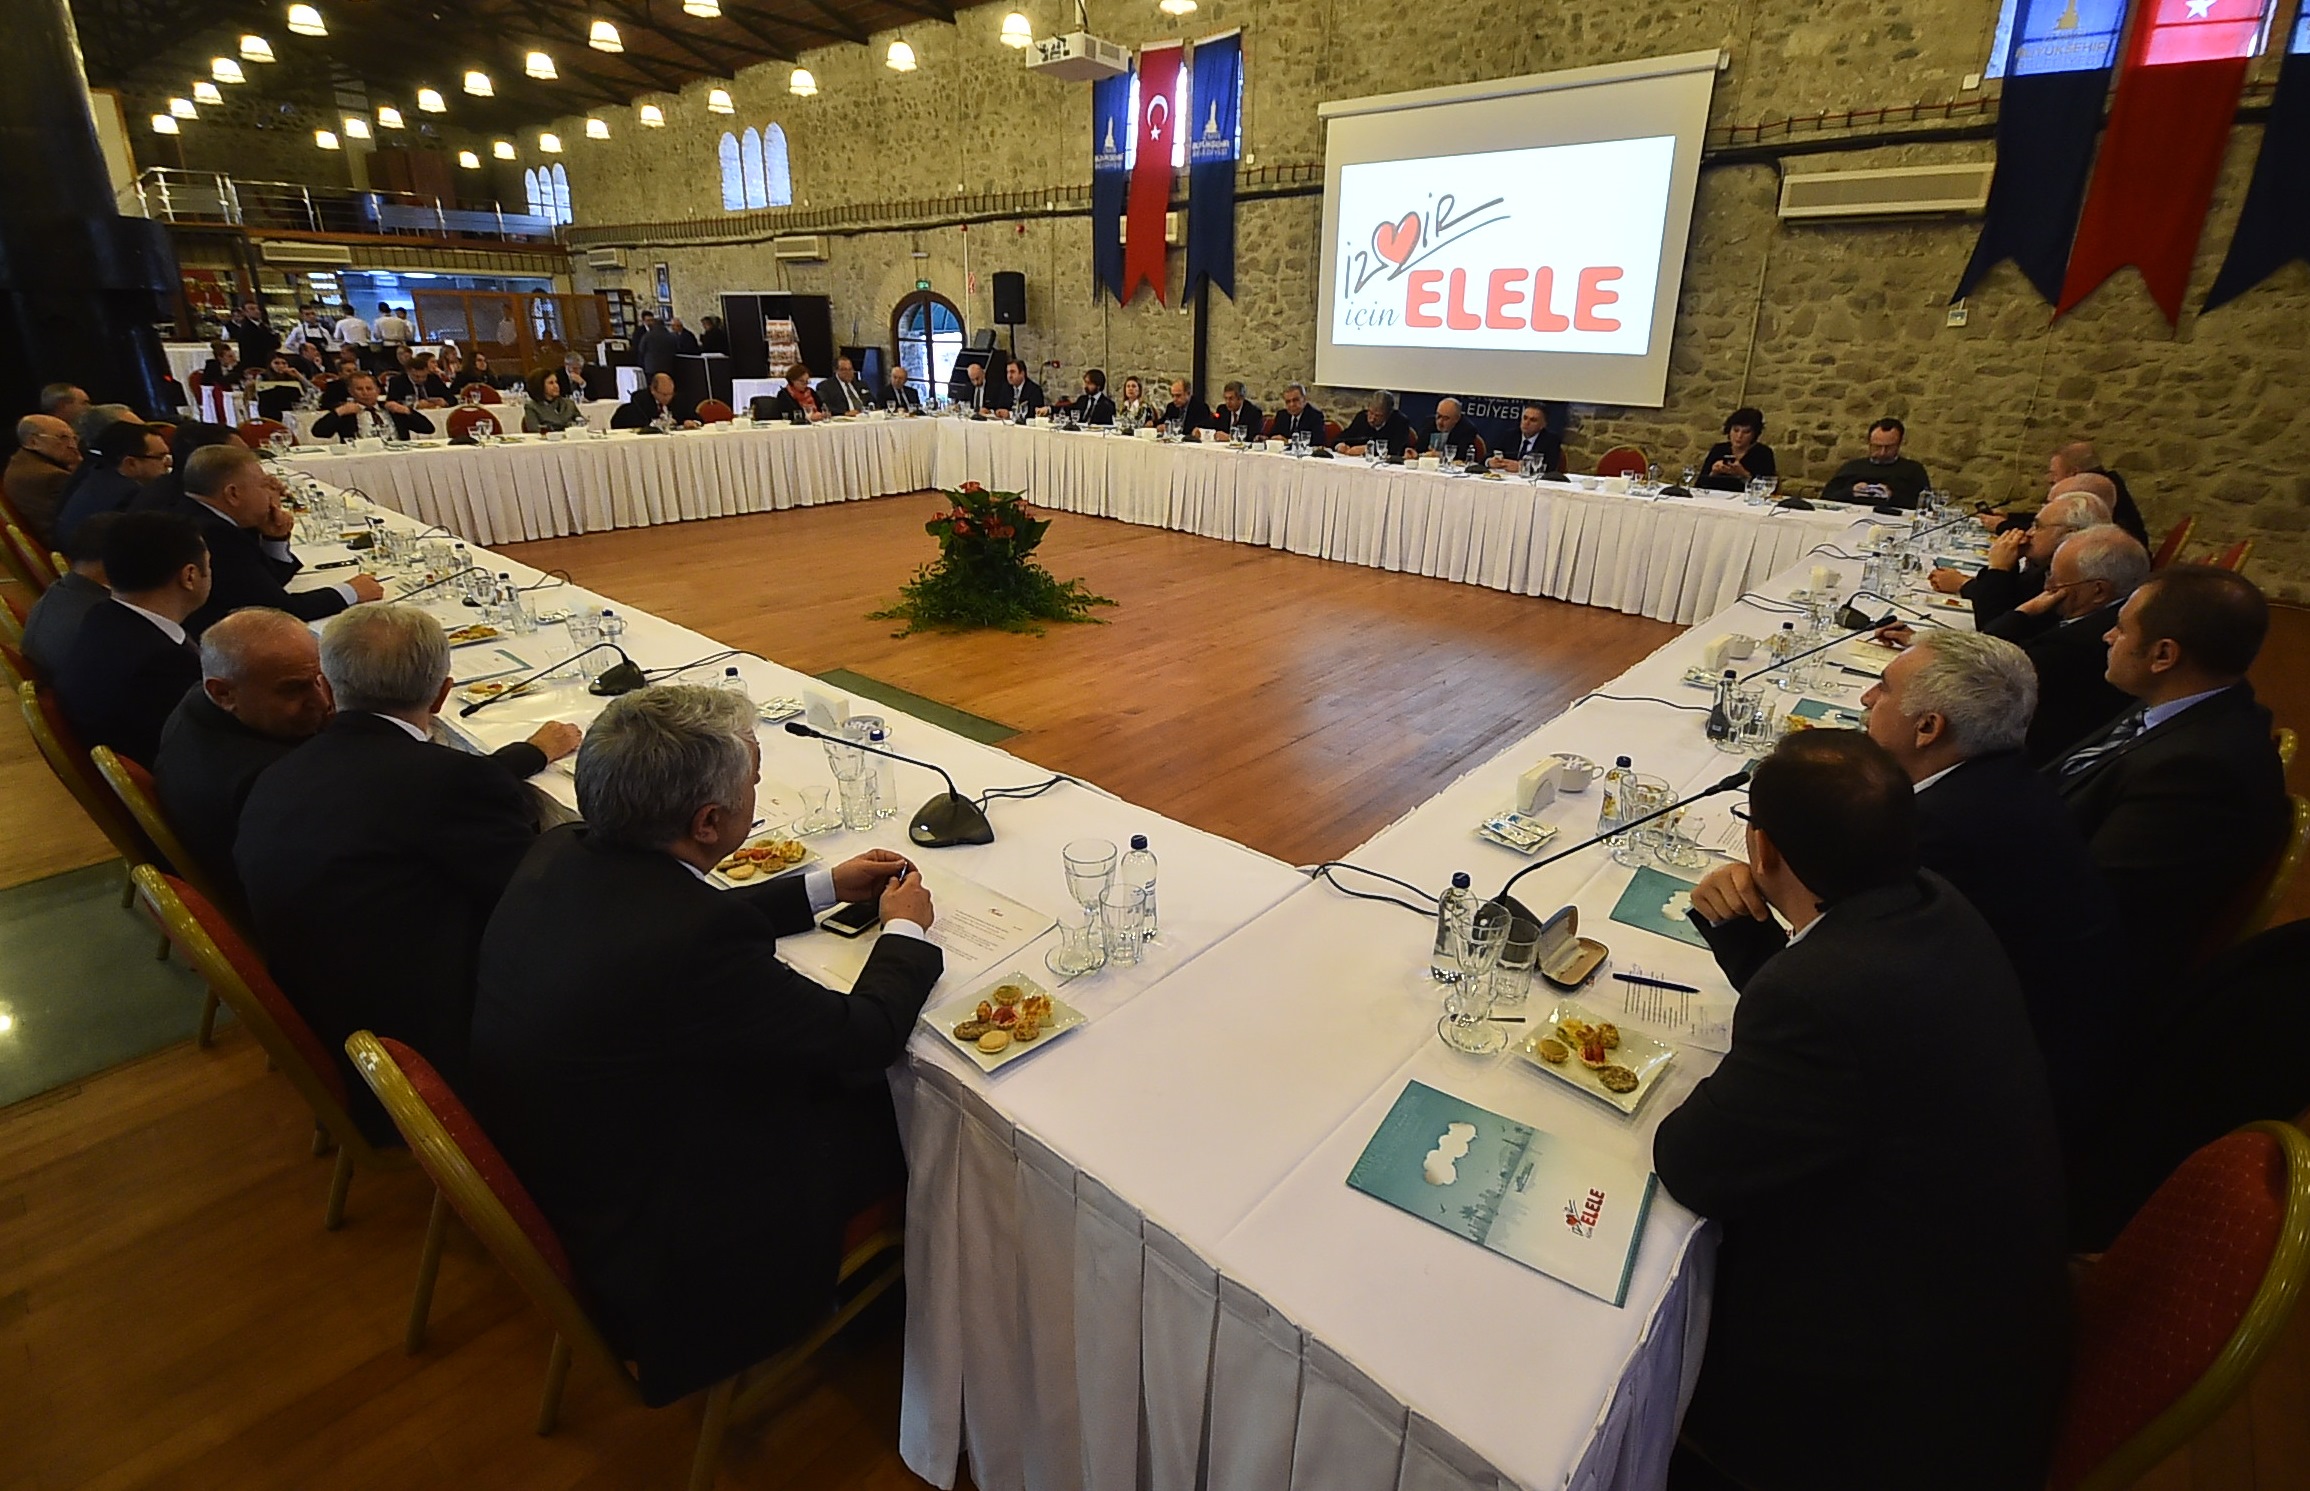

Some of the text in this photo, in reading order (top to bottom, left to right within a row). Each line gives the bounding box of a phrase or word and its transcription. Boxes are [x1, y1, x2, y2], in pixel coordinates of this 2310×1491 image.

[1345, 266, 1624, 332] için ELELE
[1580, 1188, 1605, 1227] ELELE
